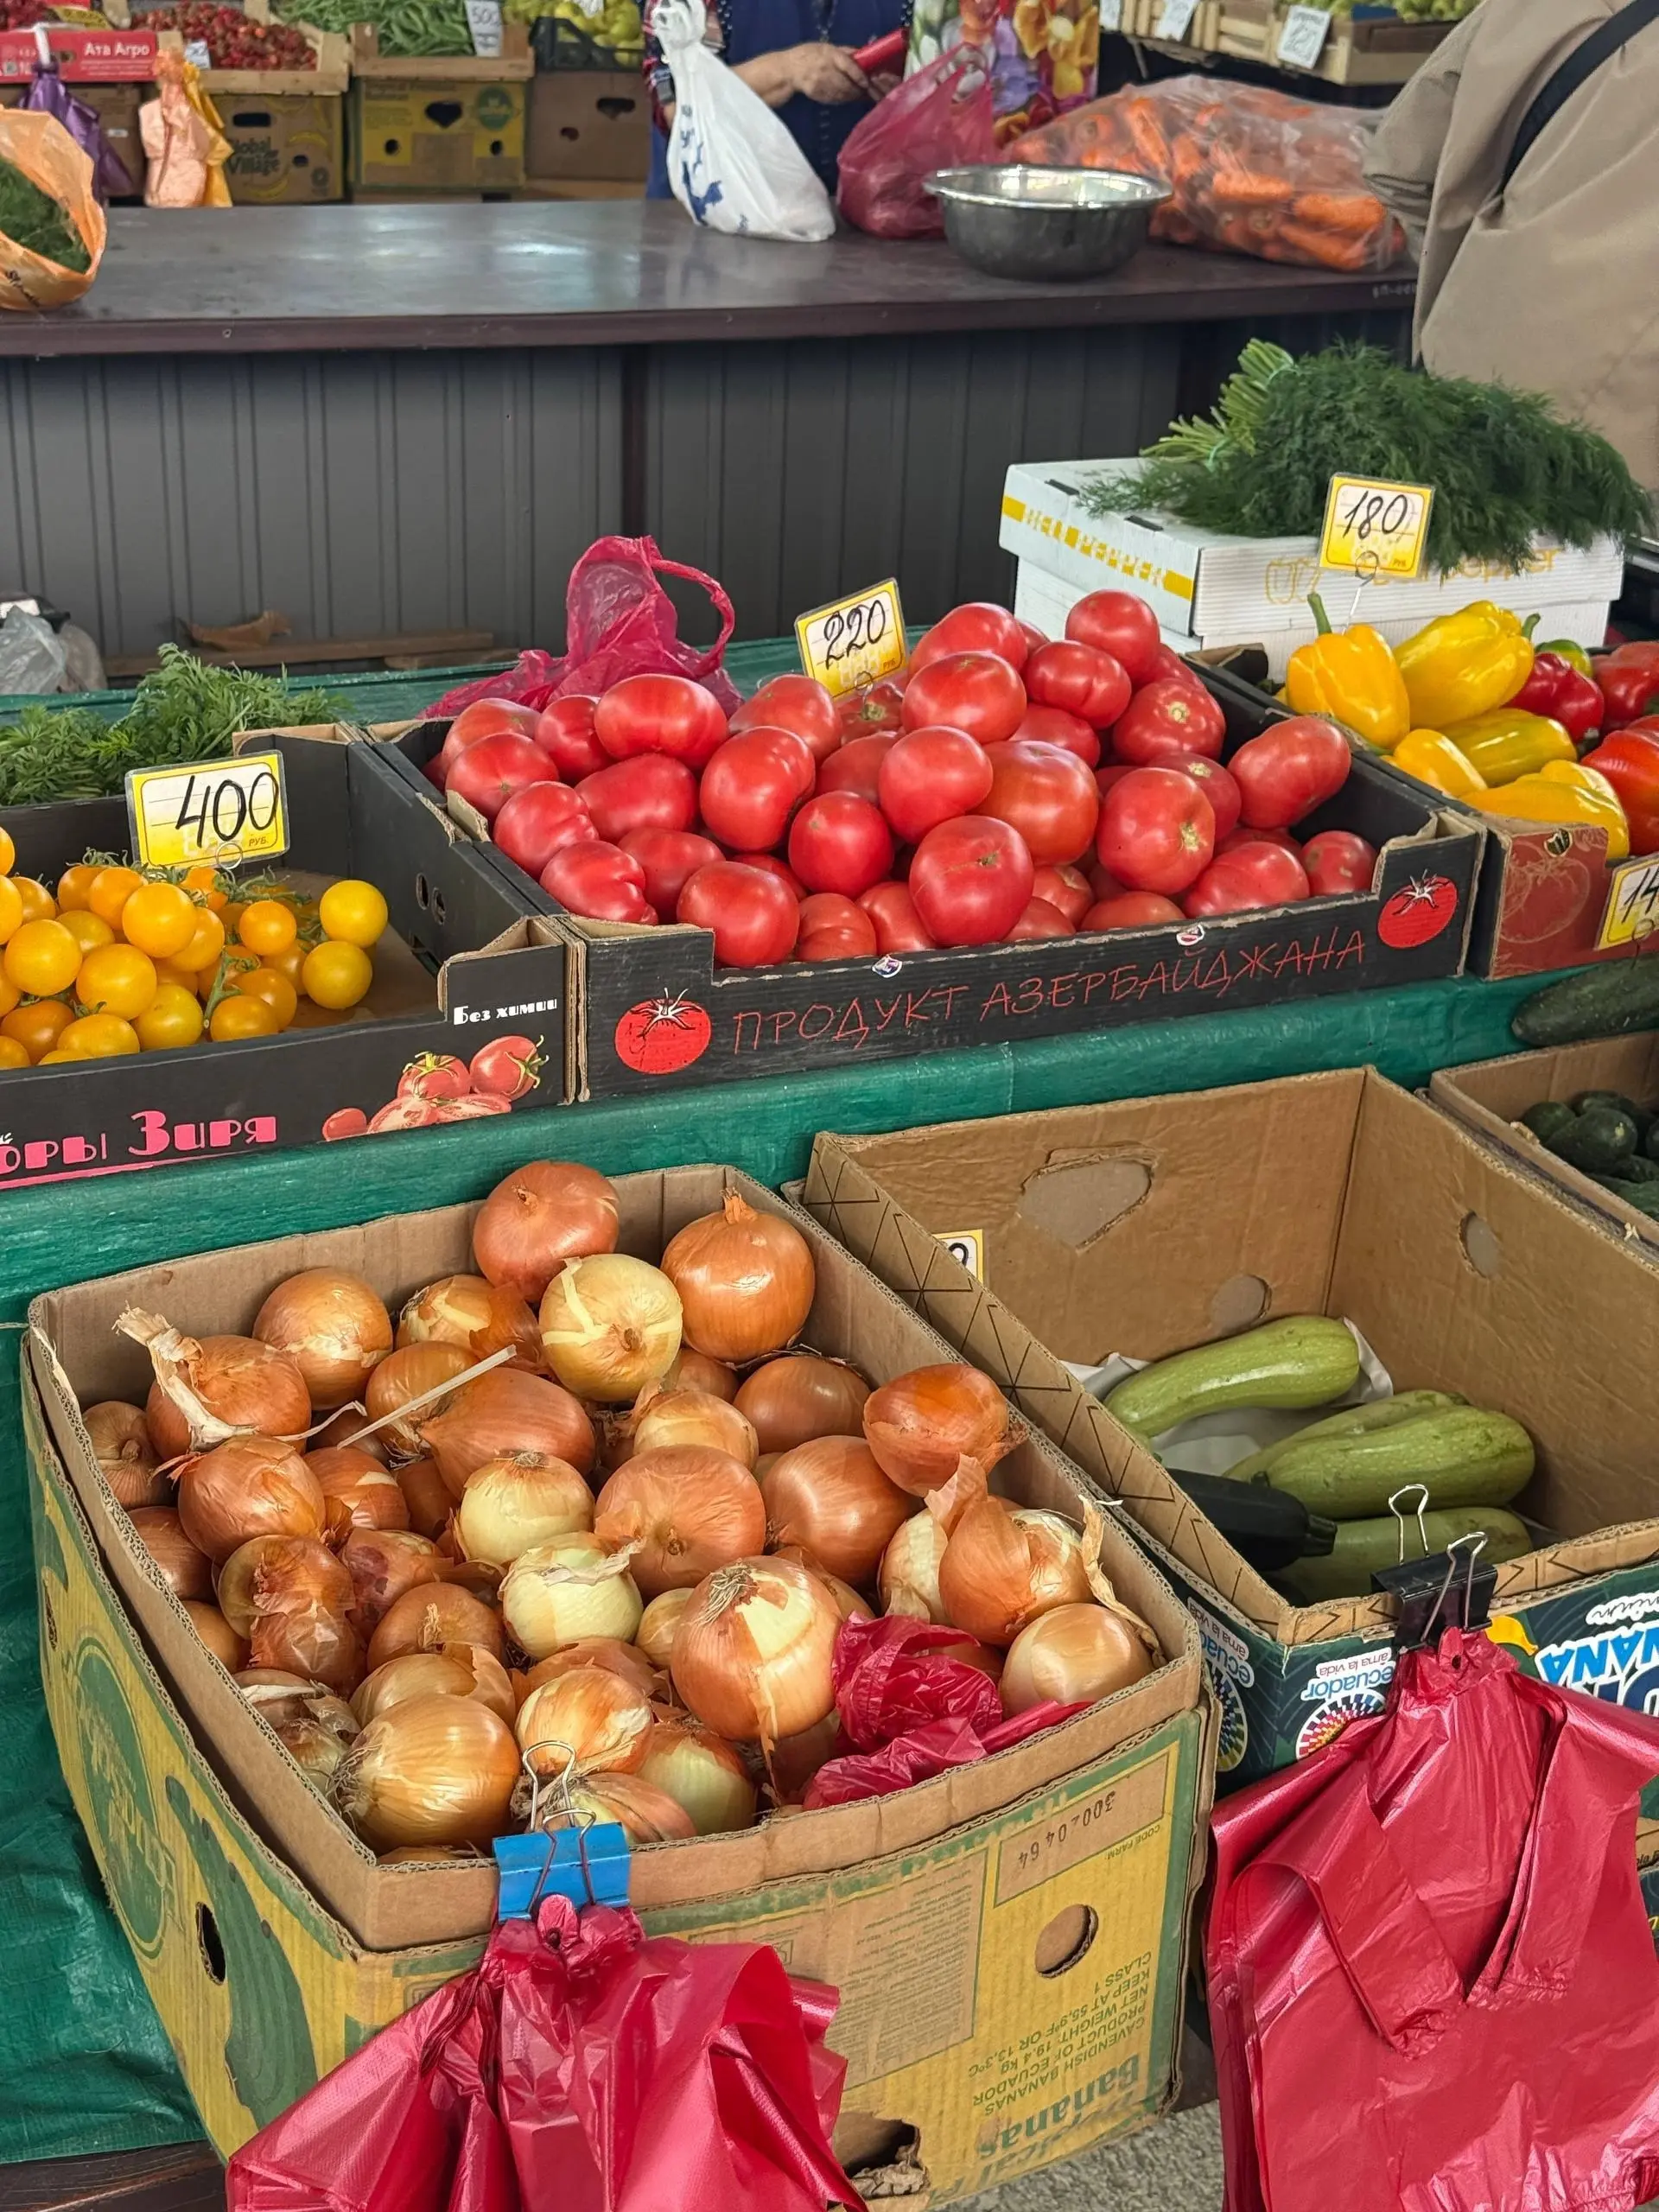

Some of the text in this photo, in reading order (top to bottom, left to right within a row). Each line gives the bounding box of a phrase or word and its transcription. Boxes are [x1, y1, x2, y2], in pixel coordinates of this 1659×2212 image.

[1343, 490, 1408, 540] 180
[823, 600, 886, 670] 220
[175, 772, 279, 848] 400
[454, 999, 557, 1026] Без химии
[734, 926, 1366, 1055] ПРОДУКТ АЗЕРБАЙДЖАНА
[1304, 1666, 1394, 1701] ecuador
[1093, 1950, 1152, 1994] CLASS 1
[1112, 1967, 1150, 2002] KEEP
[1121, 1982, 1149, 2006] NET
[1086, 1993, 1109, 2011] AT
[972, 1999, 1147, 2107] PRODUCT OF ECUADOR
[1018, 2030, 1042, 2052] OR
[983, 2016, 1146, 2117] CAVENDISH BANANAS
